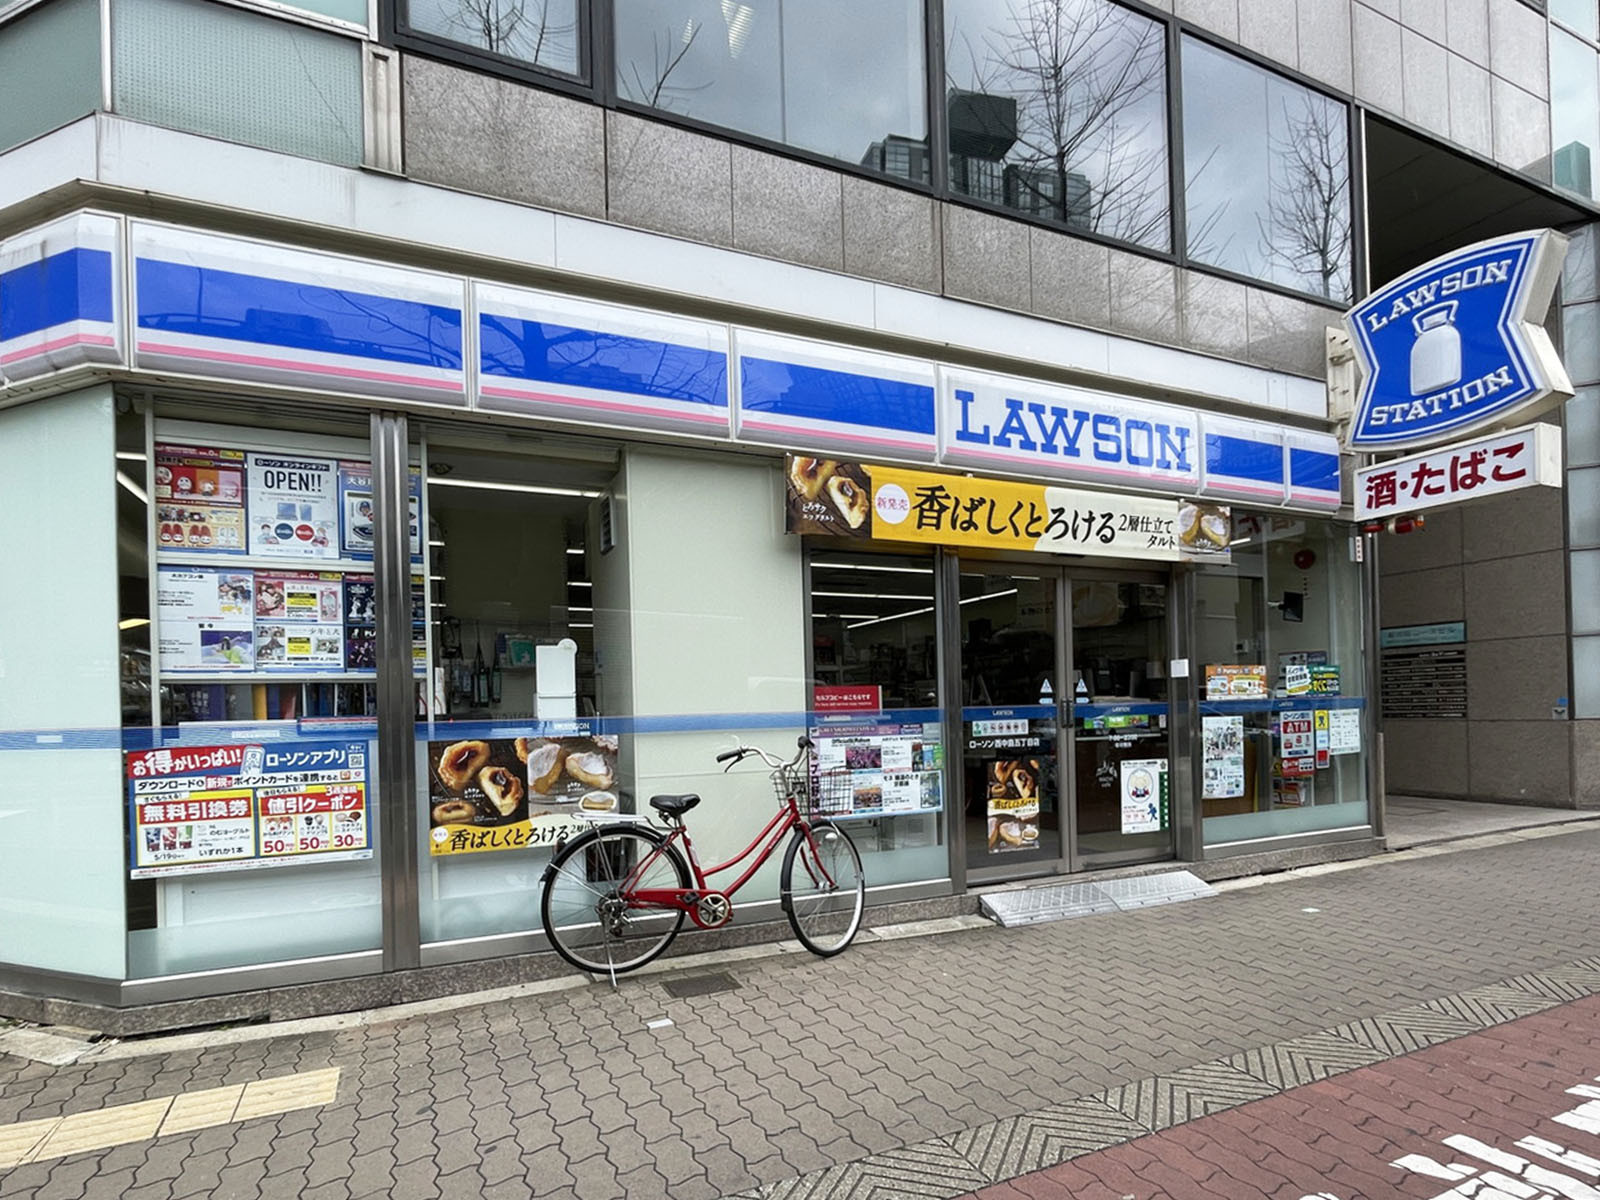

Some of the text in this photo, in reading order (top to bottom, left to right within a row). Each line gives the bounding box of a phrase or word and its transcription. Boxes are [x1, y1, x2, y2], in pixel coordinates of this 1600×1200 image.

[1367, 259, 1513, 332] LAWSON
[1370, 366, 1515, 427] STATION
[955, 389, 1192, 472] LAWSON
[264, 470, 322, 492] OPEN!!
[1366, 442, 1527, 509] 酒・たばこ
[877, 496, 909, 511] 新発売
[912, 485, 1117, 545] 香ばしくとろける
[1118, 512, 1174, 534] 2層仕立て
[1146, 534, 1177, 551] タルト
[1287, 721, 1309, 733] ATM
[266, 749, 346, 767] ローソンアプリ
[143, 799, 249, 823] 無料引換券
[267, 795, 358, 815] 値引クーポン
[263, 840, 285, 853] 50
[299, 837, 320, 850] 50
[333, 834, 354, 847] 30
[449, 824, 569, 851] 香ばしくとろける
